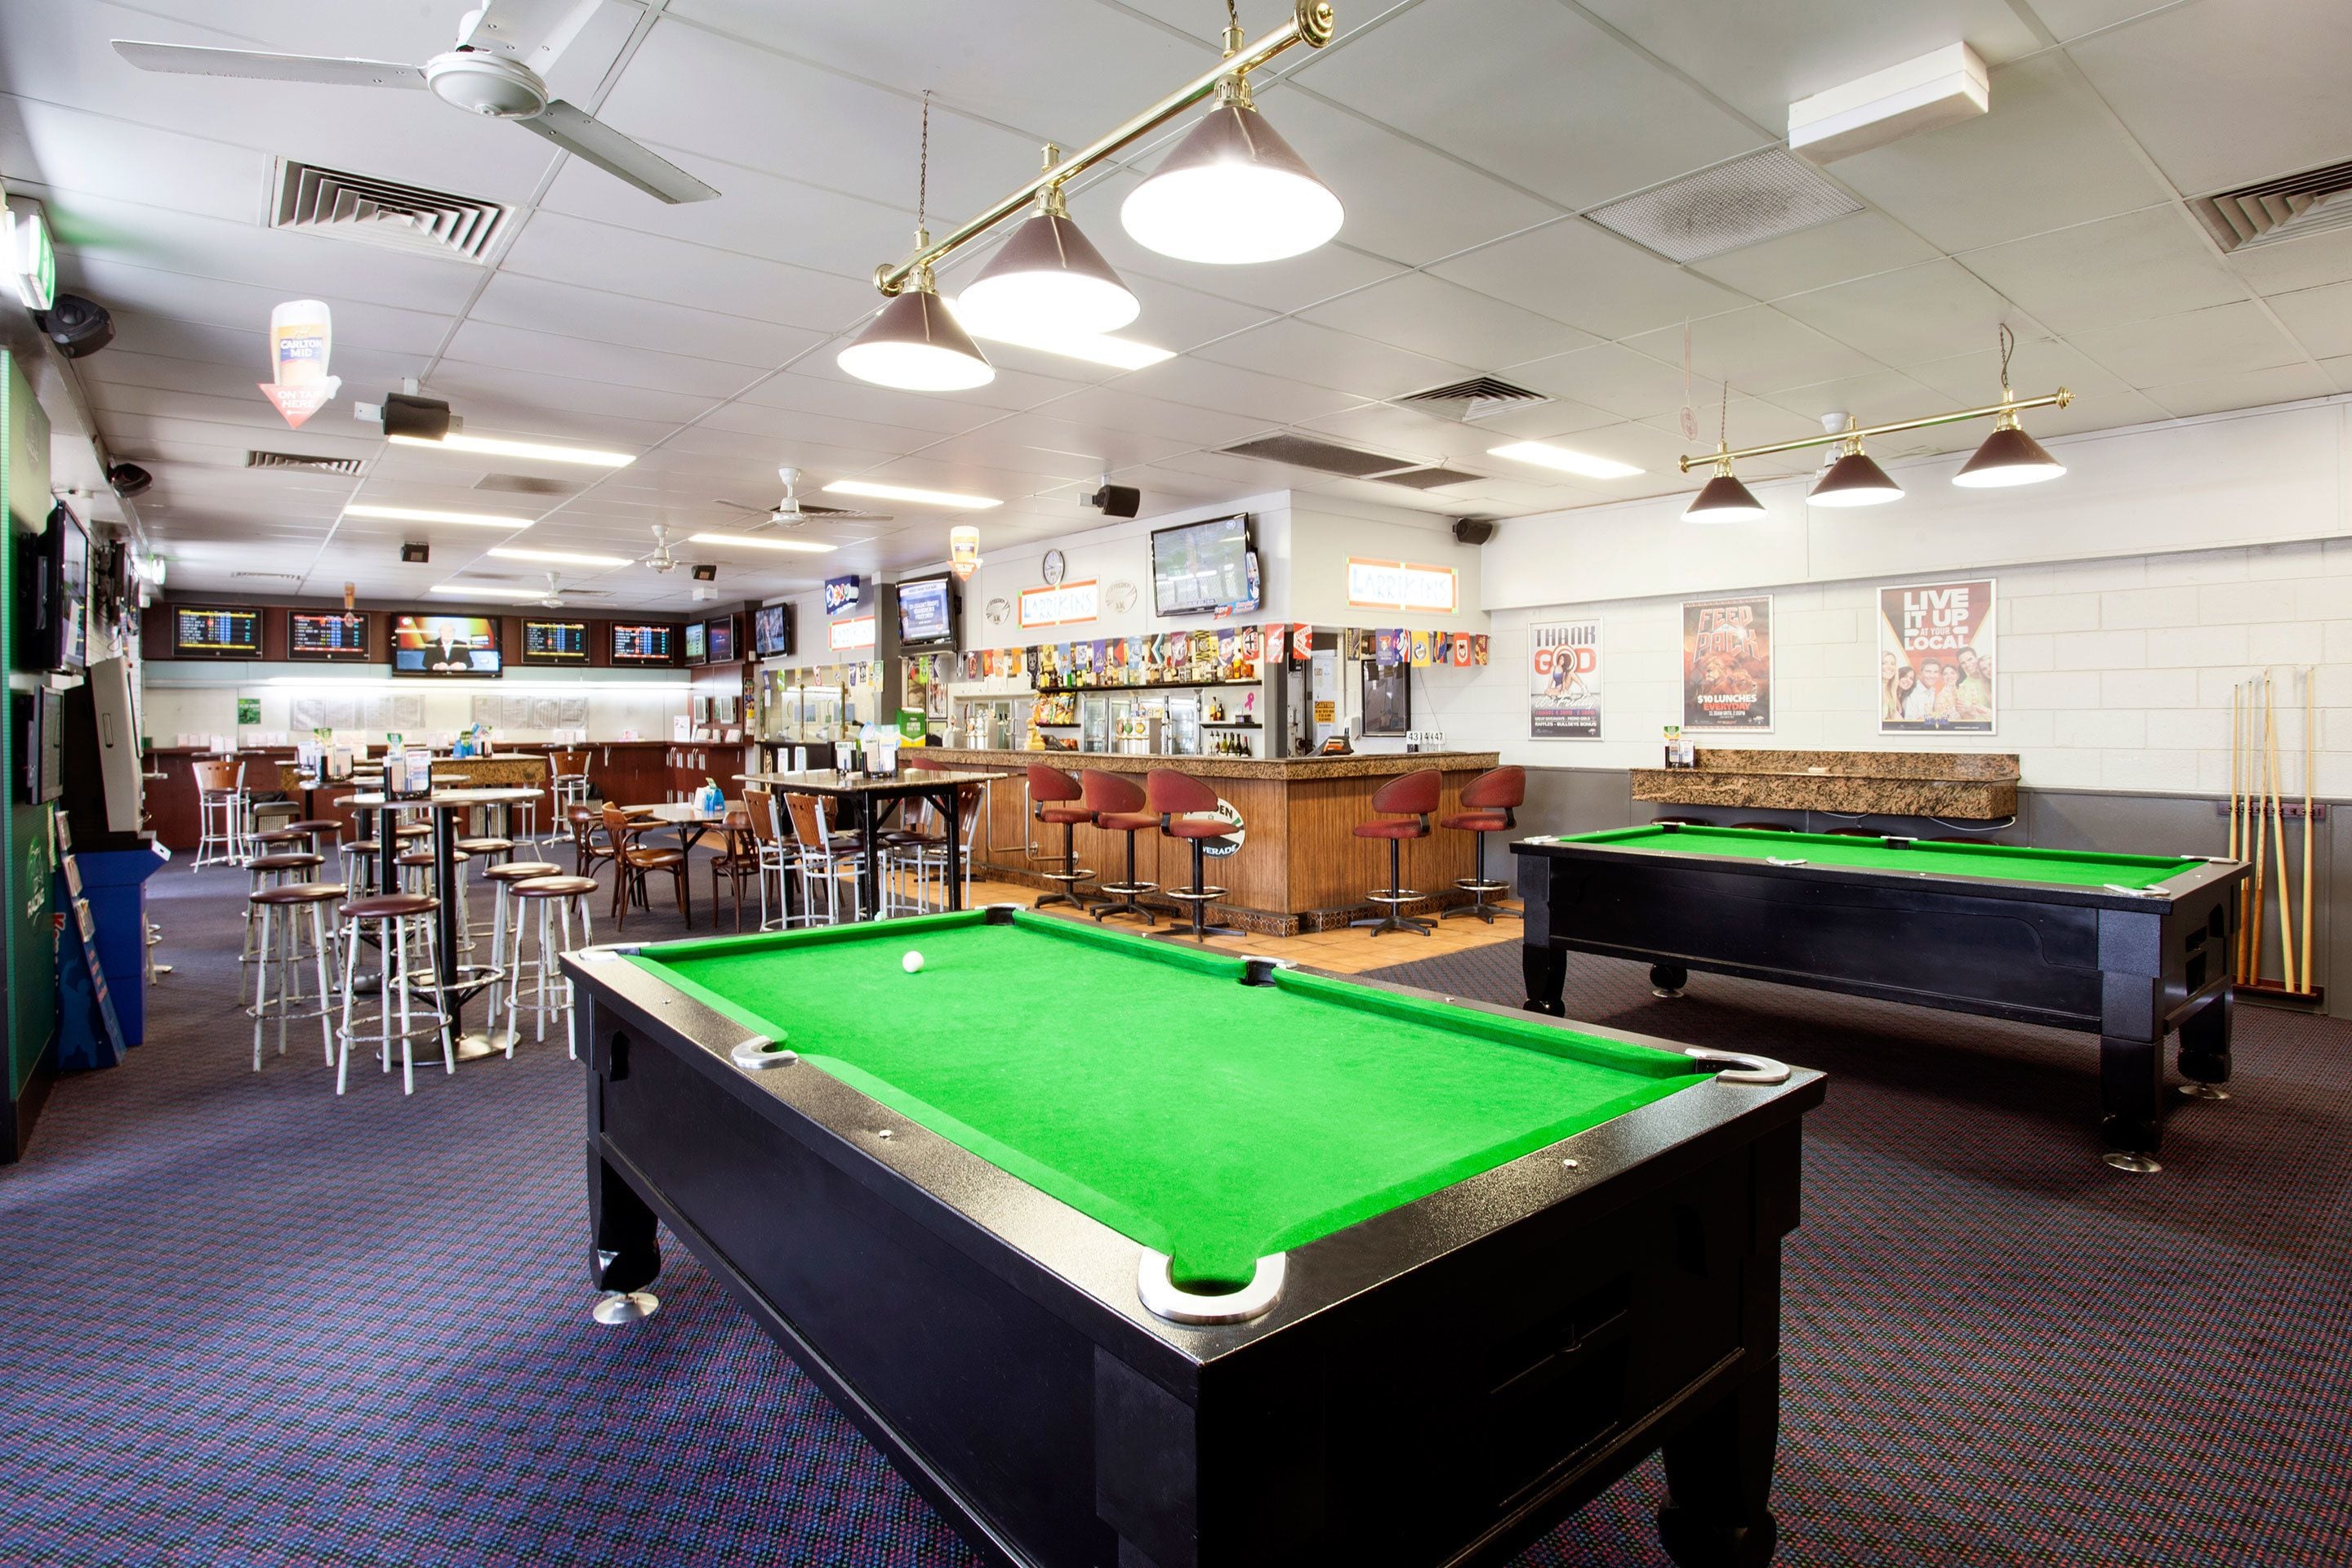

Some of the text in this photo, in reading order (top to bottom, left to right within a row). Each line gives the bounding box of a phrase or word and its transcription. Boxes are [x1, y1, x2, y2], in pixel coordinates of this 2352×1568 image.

[280, 339, 323, 349] CARLTON
[291, 348, 313, 358] MID
[278, 390, 296, 399] ON
[282, 399, 315, 408] HERE
[1904, 588, 1969, 611] LIVE
[1698, 606, 1753, 632] FEED
[1904, 608, 1969, 628] IT UP
[1535, 626, 1596, 647] THANK
[1920, 627, 1950, 636] AT YOUR
[1693, 628, 1762, 663] PACK
[1904, 635, 1969, 651] LOCAL
[1534, 644, 1597, 675] GOD
[1698, 694, 1757, 704] $10 LUNCHES
[1703, 702, 1752, 710] EVERYDAY
[1408, 732, 1419, 742] 43
[1434, 732, 1443, 741] 47
